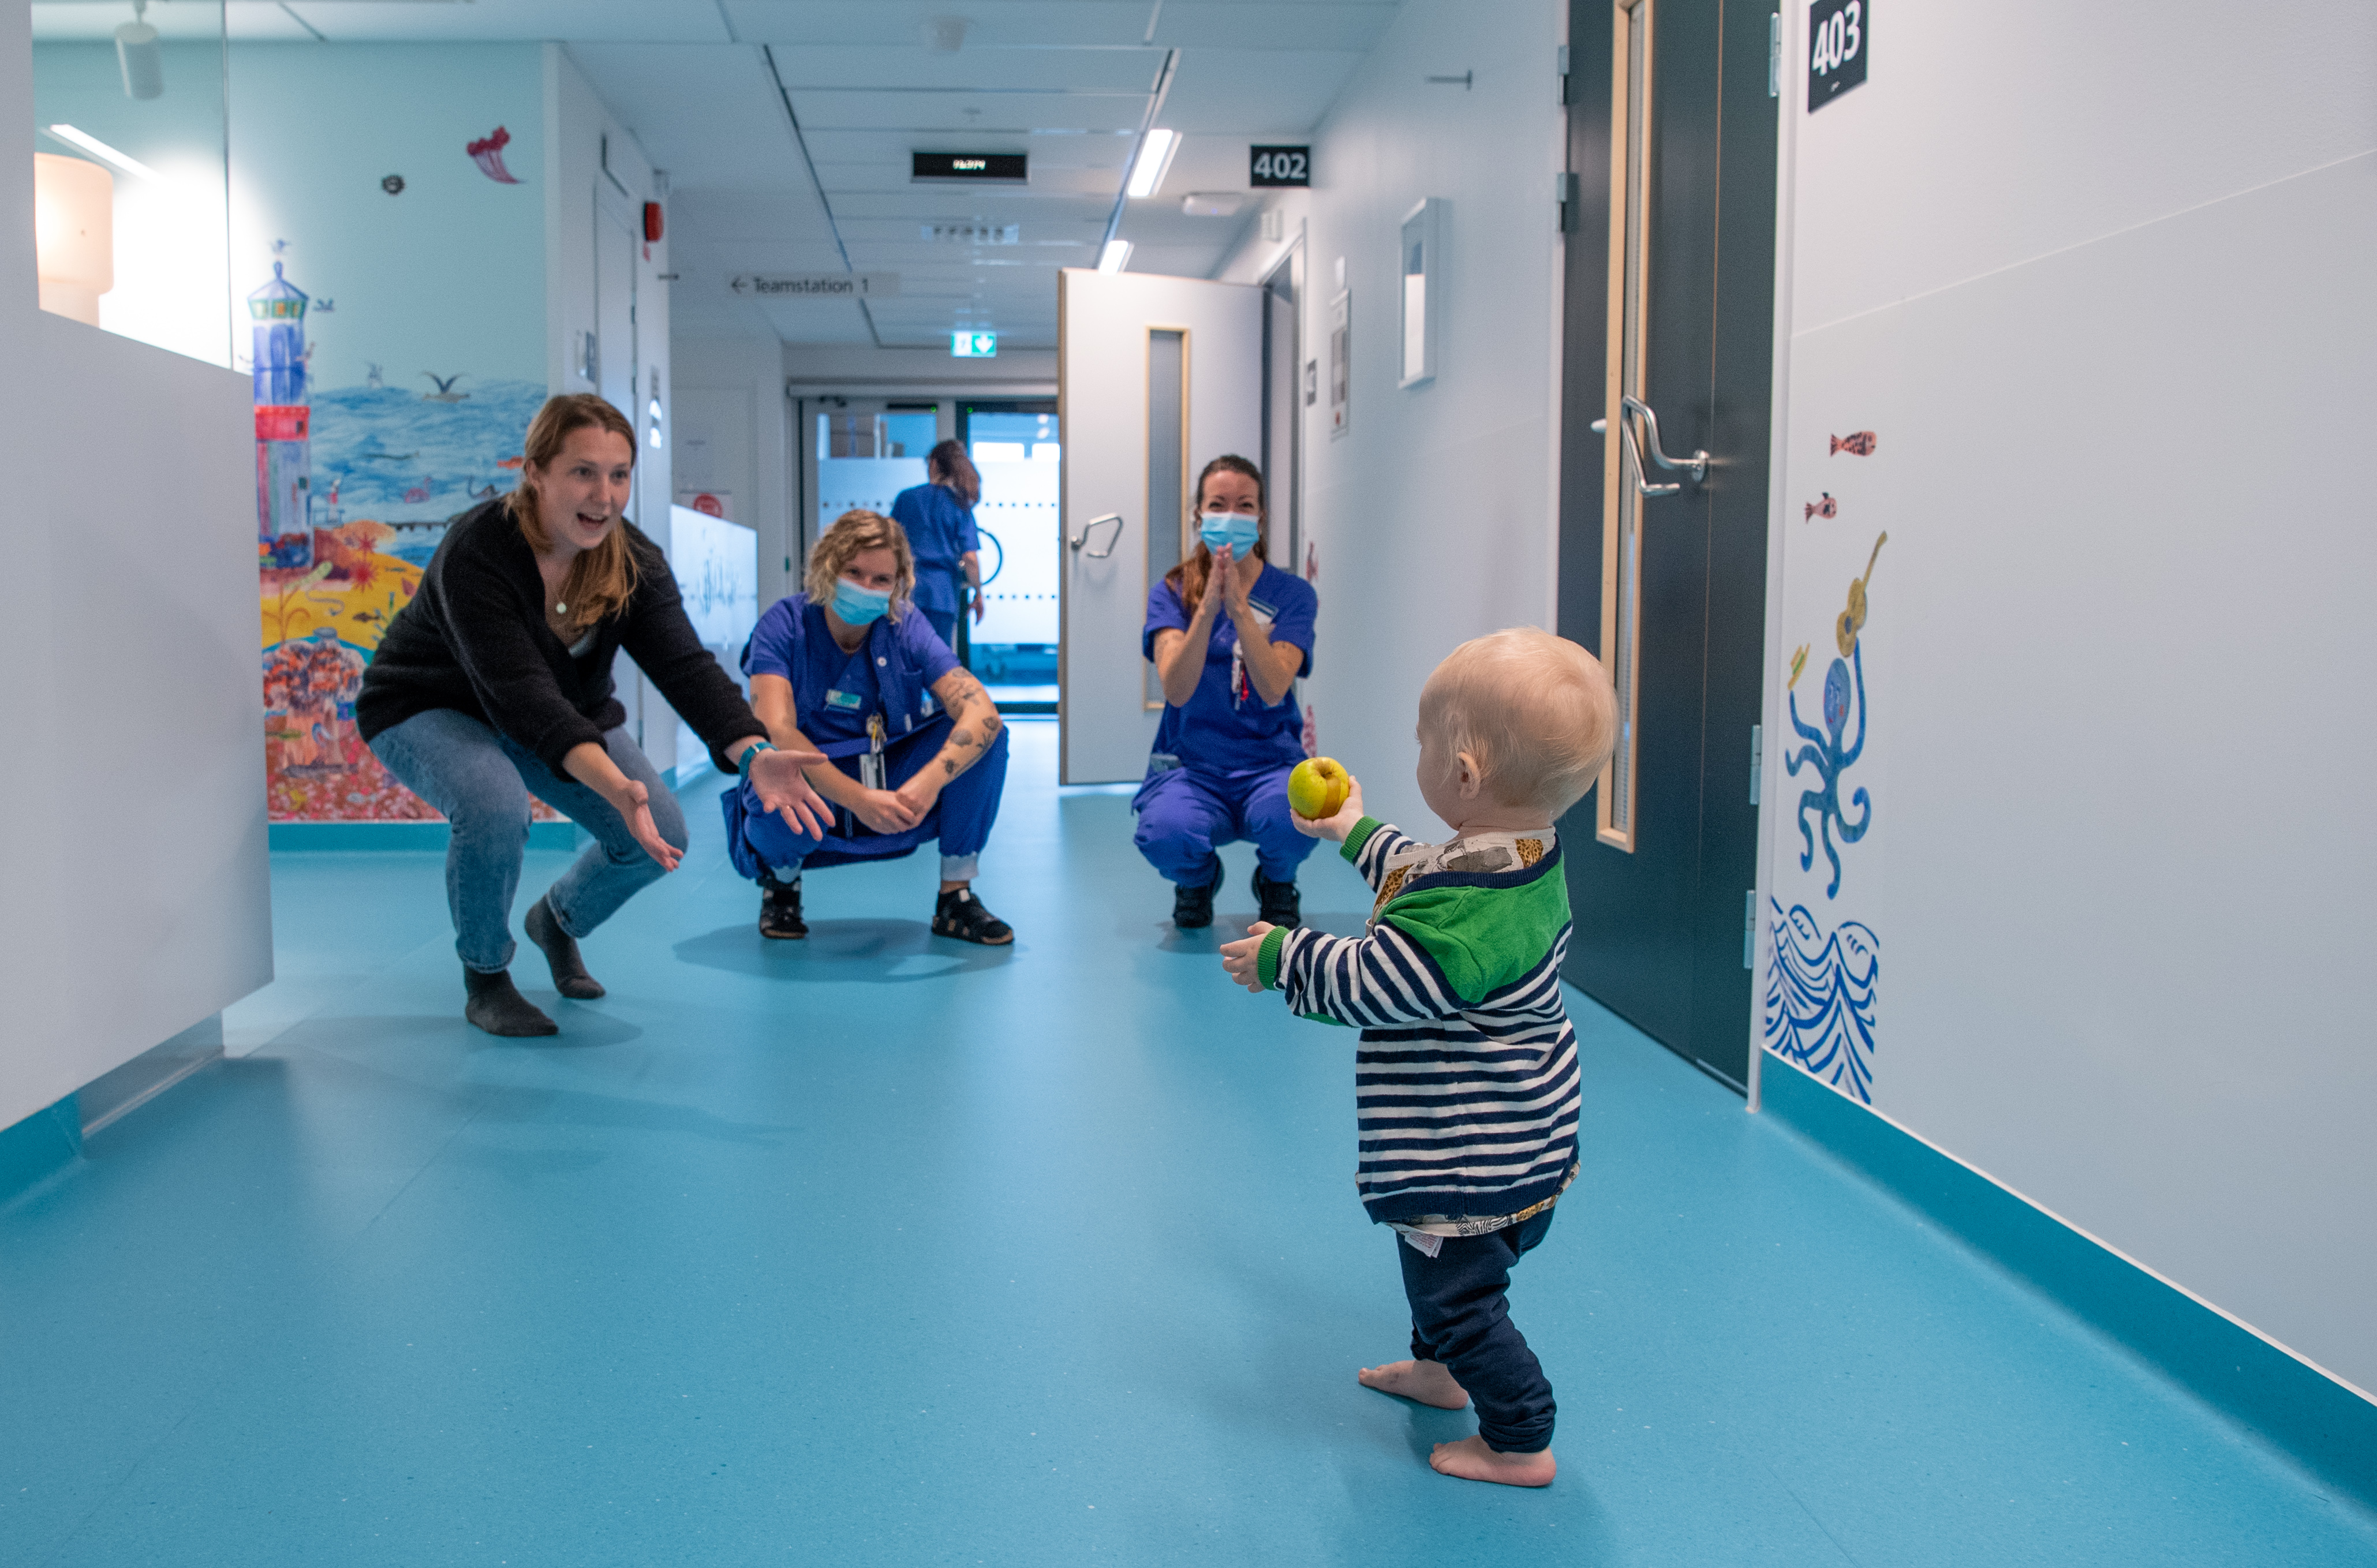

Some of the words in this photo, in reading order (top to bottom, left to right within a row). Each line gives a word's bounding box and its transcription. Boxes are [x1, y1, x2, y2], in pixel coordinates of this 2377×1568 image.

[1811, 0, 1861, 76] 403
[1253, 152, 1306, 179] 402
[753, 276, 853, 293] Teamstation
[861, 276, 868, 293] 1
